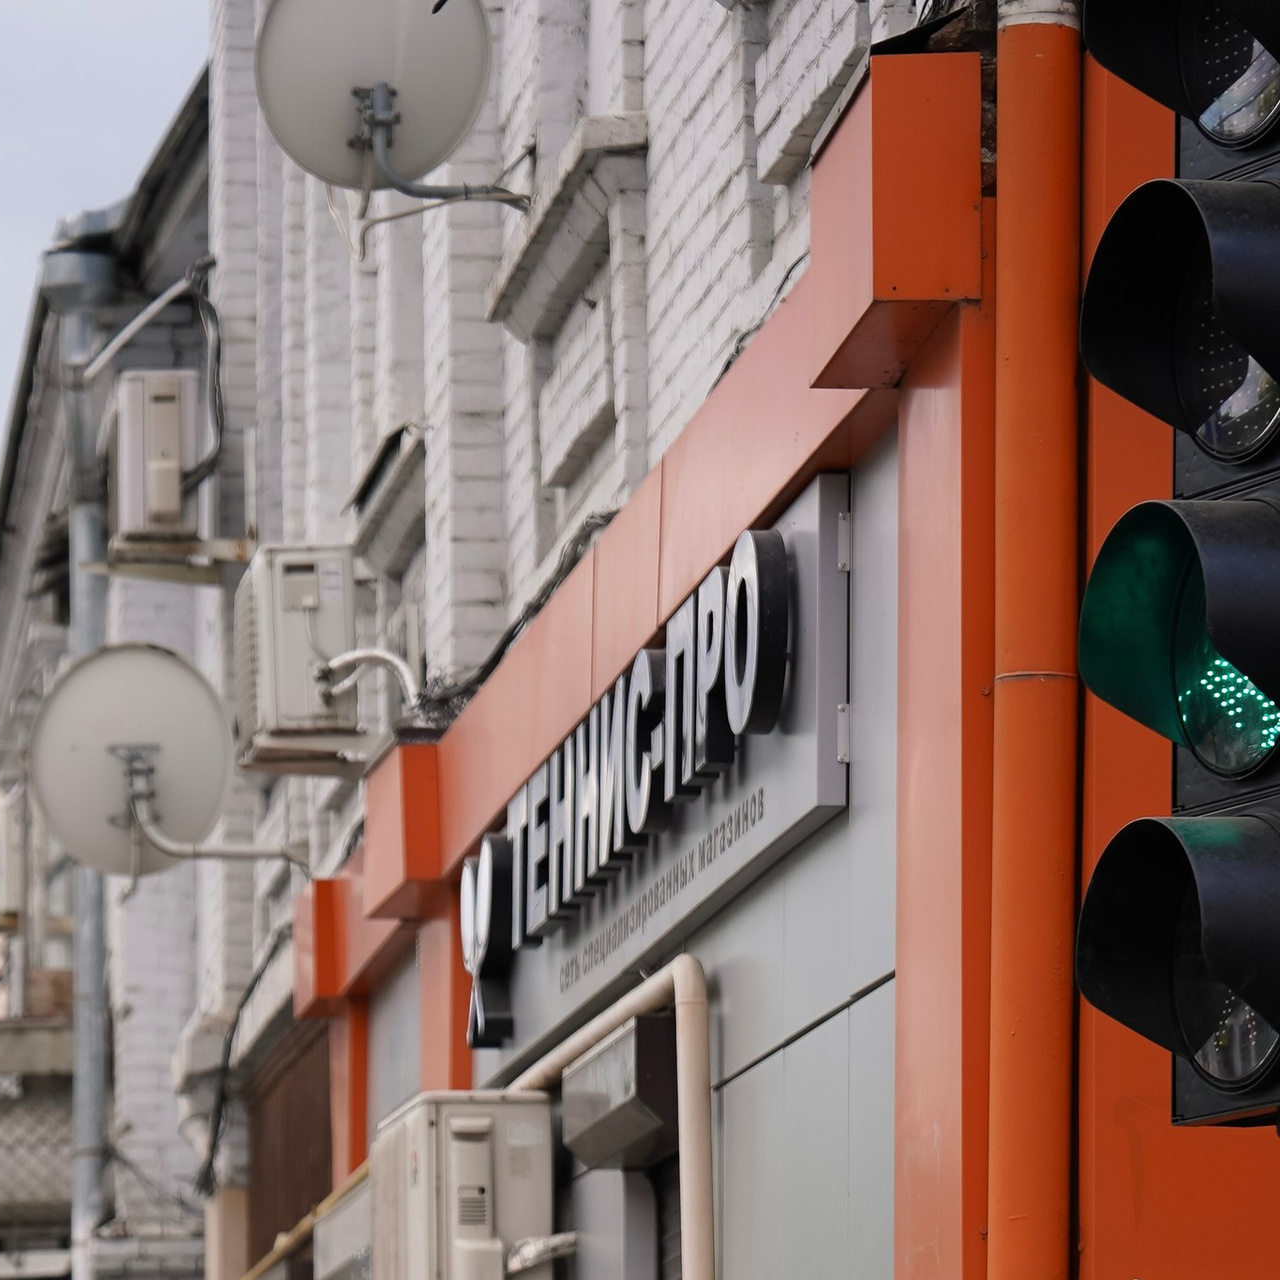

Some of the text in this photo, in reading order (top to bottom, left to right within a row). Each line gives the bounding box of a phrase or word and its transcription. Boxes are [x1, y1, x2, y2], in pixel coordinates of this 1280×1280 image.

[506, 529, 782, 951] ТЕННИС-ПРО
[558, 955, 580, 994] сеть
[698, 786, 764, 873] магазинов
